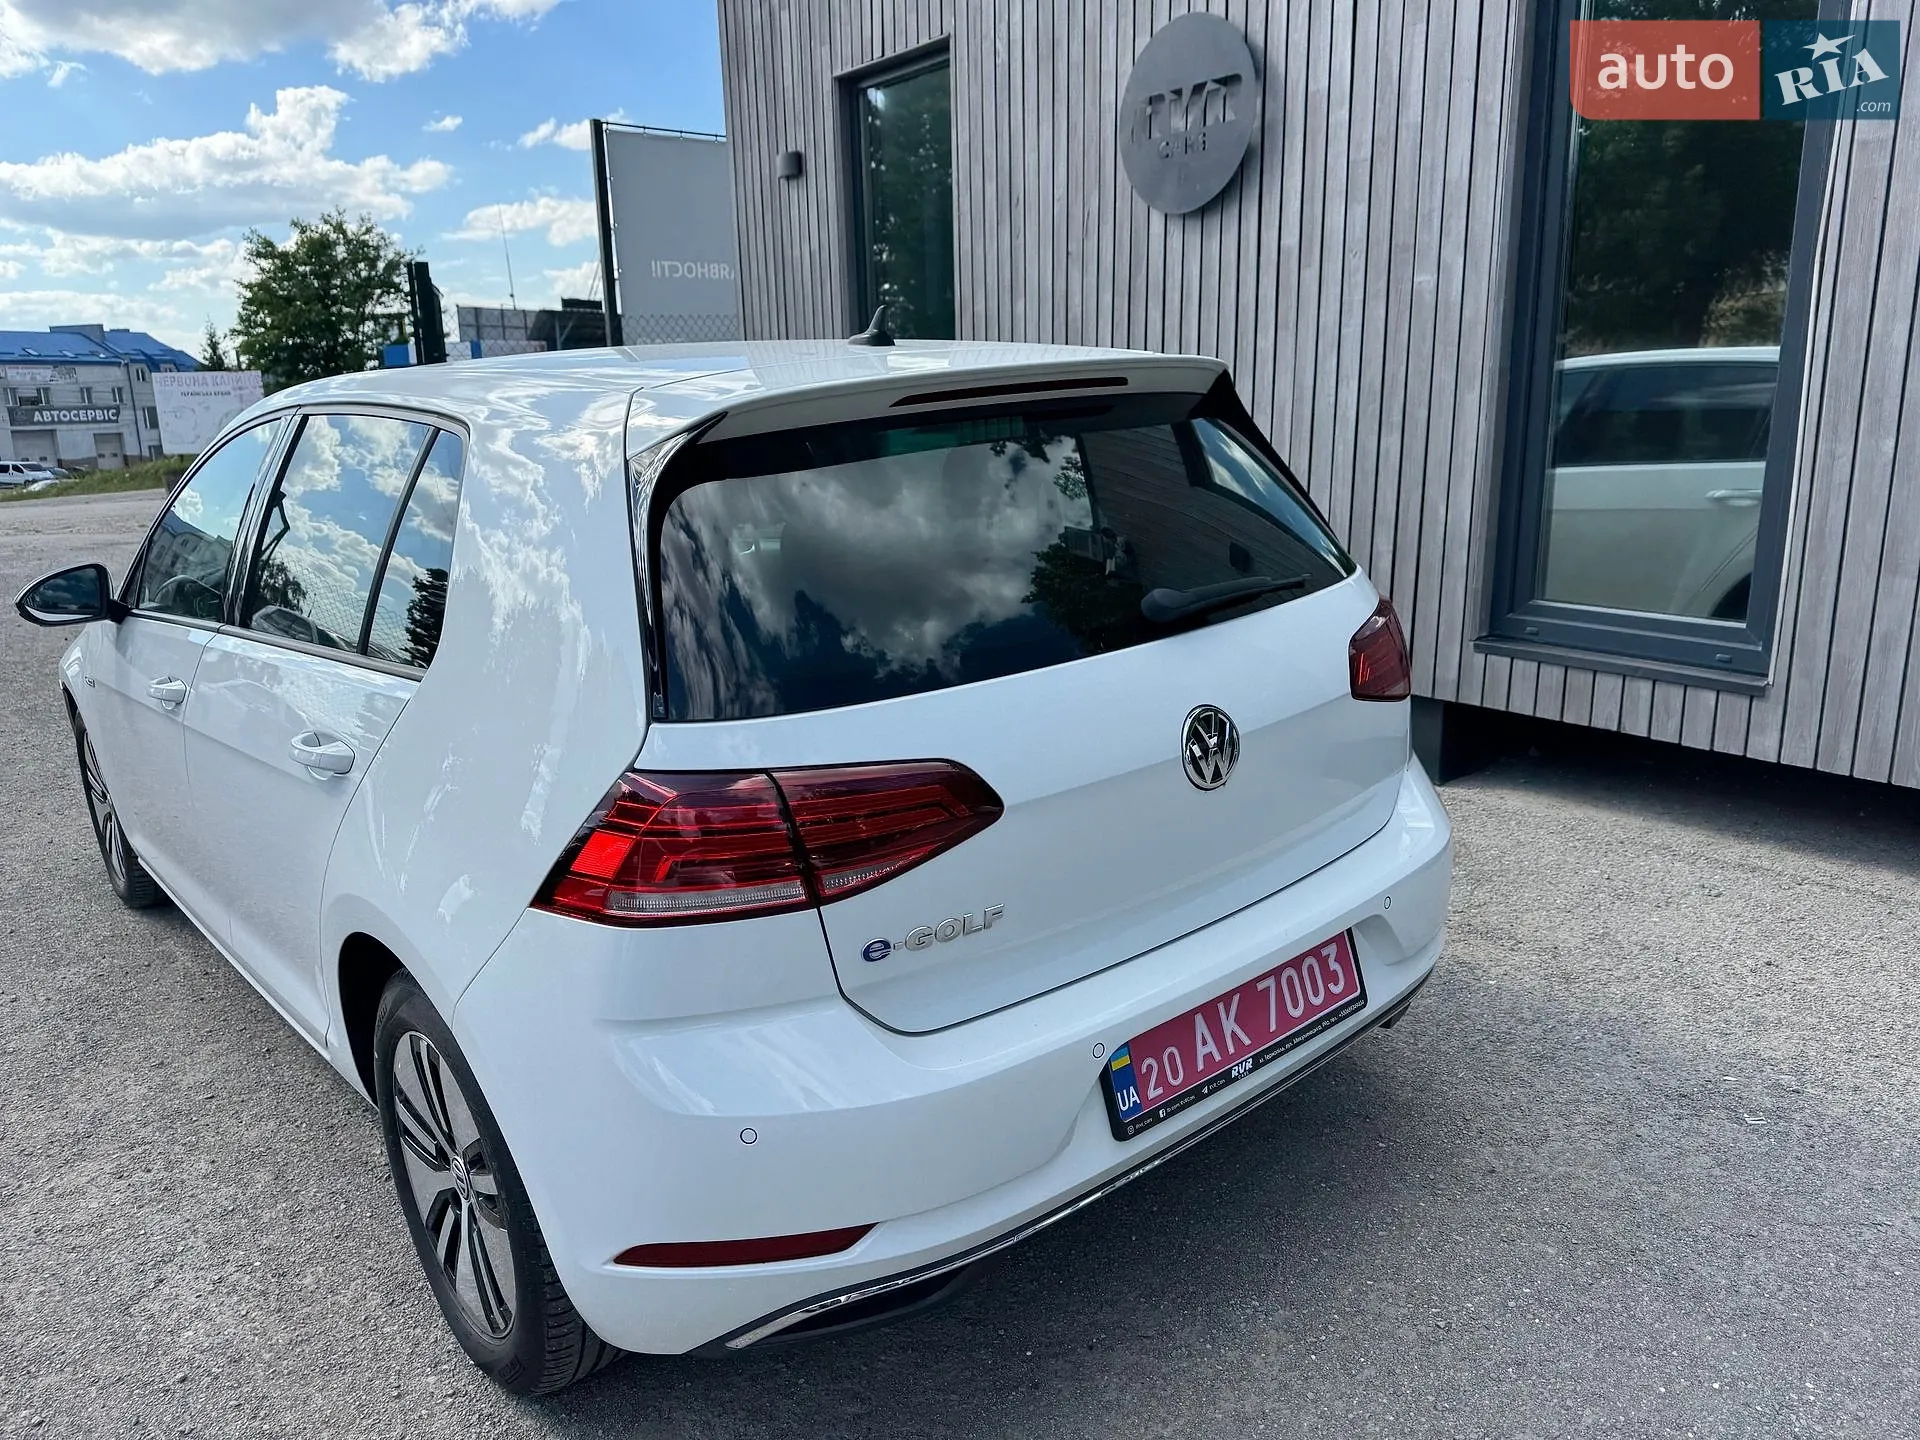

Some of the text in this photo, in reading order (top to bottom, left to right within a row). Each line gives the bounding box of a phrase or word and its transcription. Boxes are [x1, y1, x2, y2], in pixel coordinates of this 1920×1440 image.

[34, 409, 117, 422] АВТОСЕРВІС
[862, 903, 1005, 963] e-GOLF
[1141, 1046, 1184, 1101] 20
[1194, 992, 1252, 1073] AK
[1256, 942, 1346, 1033] 7003
[1231, 1057, 1253, 1079] RVR
[1118, 1085, 1141, 1111] UA
